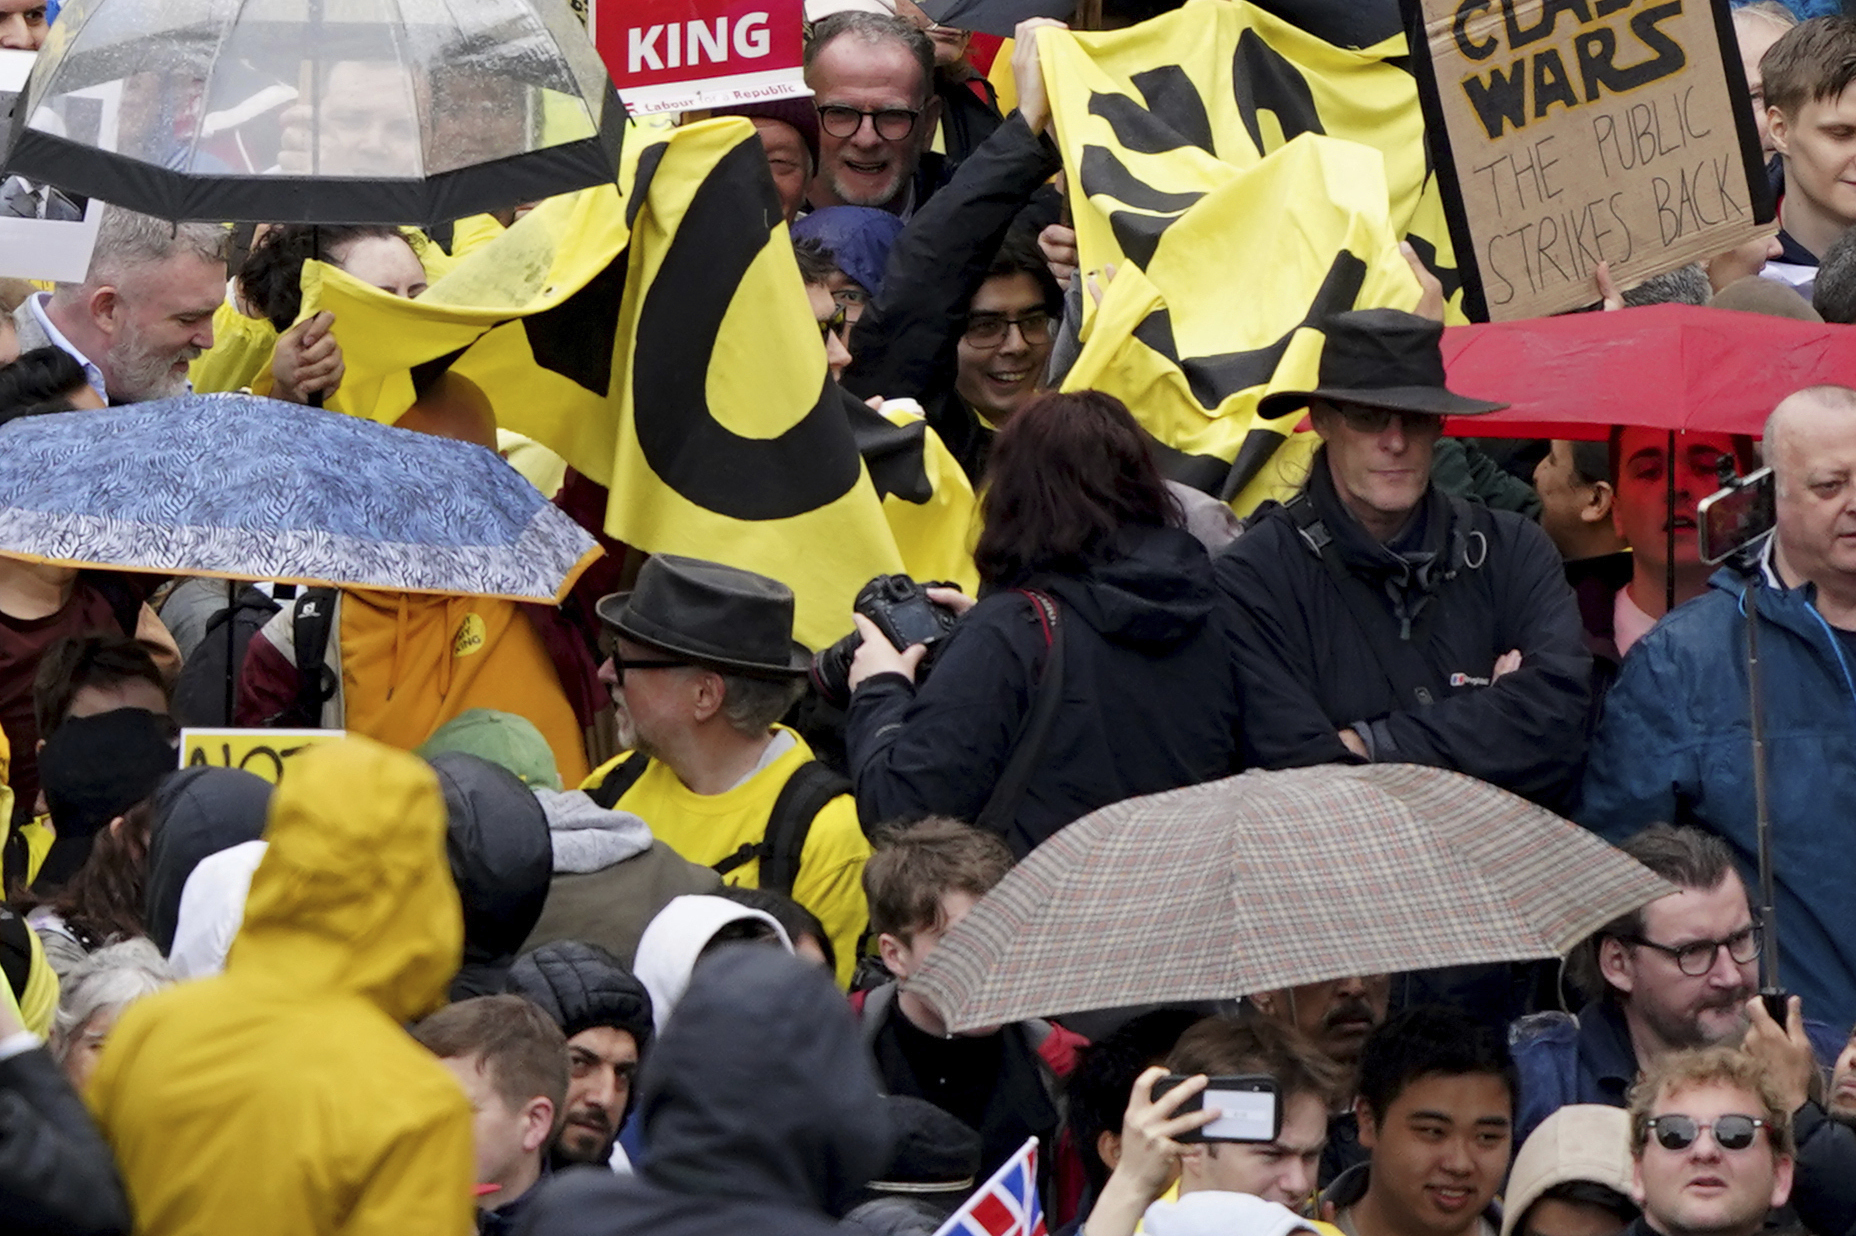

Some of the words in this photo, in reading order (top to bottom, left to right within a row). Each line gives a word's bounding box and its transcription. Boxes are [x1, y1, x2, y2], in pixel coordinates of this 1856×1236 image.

[627, 11, 772, 74] KING
[644, 98, 694, 113] Labour
[733, 84, 796, 101] Republic
[1459, 0, 1686, 140] WARS
[1474, 135, 1562, 218] THE
[1592, 85, 1712, 178] PUBLIC
[1487, 192, 1632, 306] STRIKES
[1655, 154, 1746, 248] BACK
